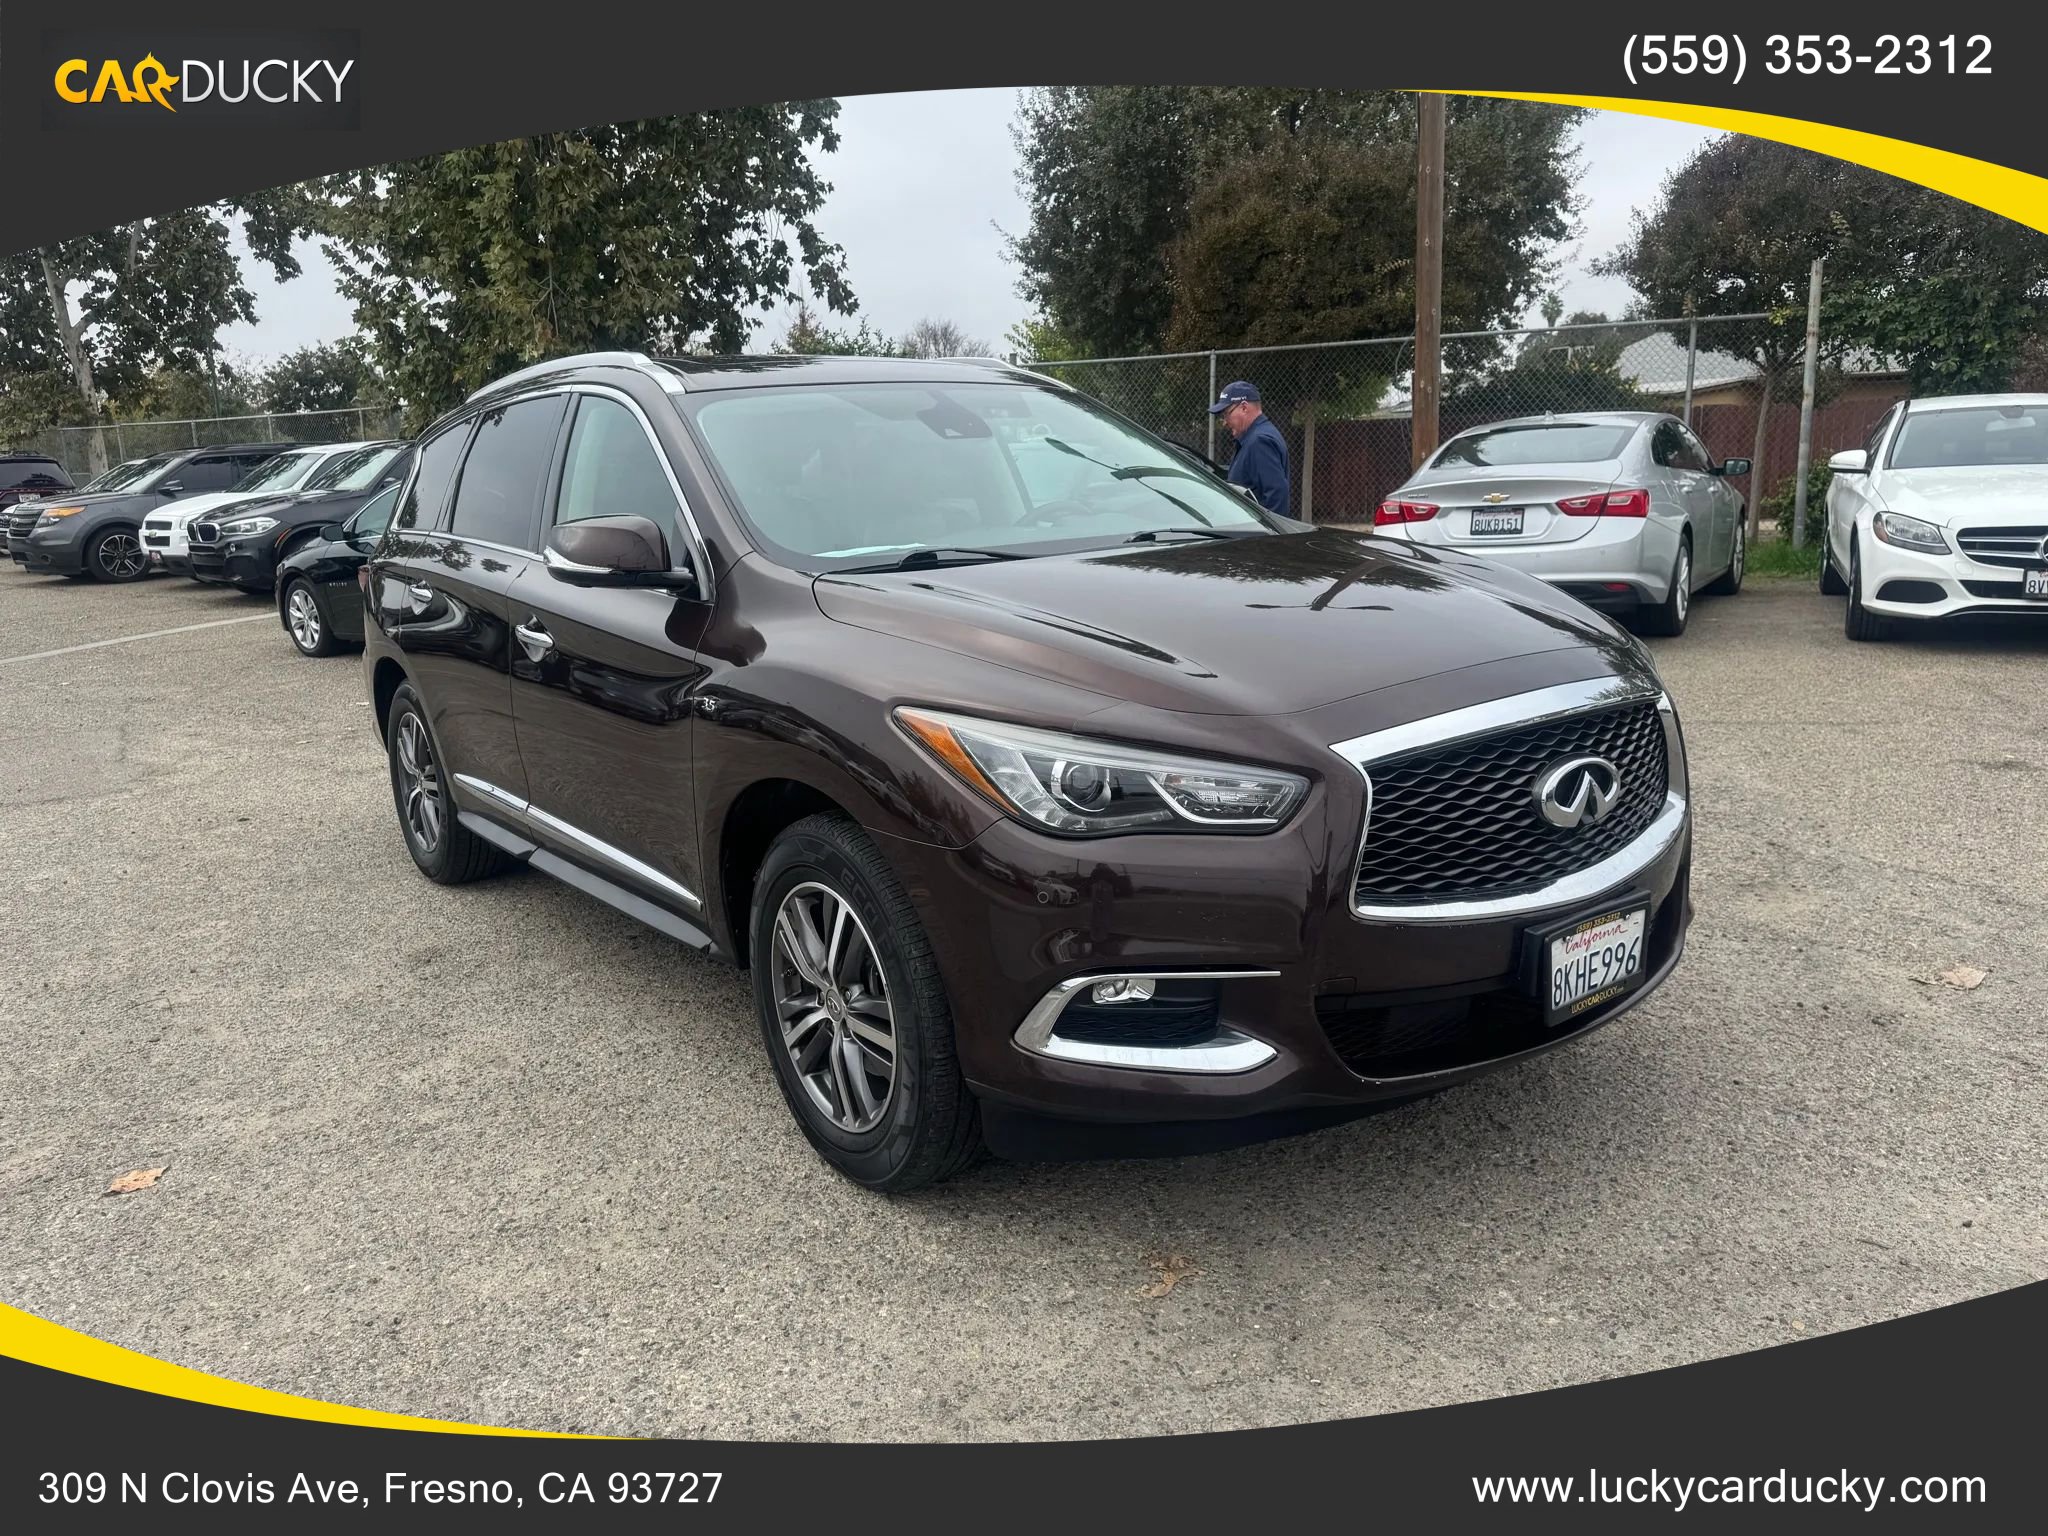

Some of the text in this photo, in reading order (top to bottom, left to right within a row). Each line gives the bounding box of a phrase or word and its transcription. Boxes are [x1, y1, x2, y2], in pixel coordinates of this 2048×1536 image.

[1474, 518, 1518, 532] 8UKB151
[2028, 579, 2048, 594] 8V
[1565, 923, 1628, 954] California
[1553, 936, 1640, 1006] 8KHE996
